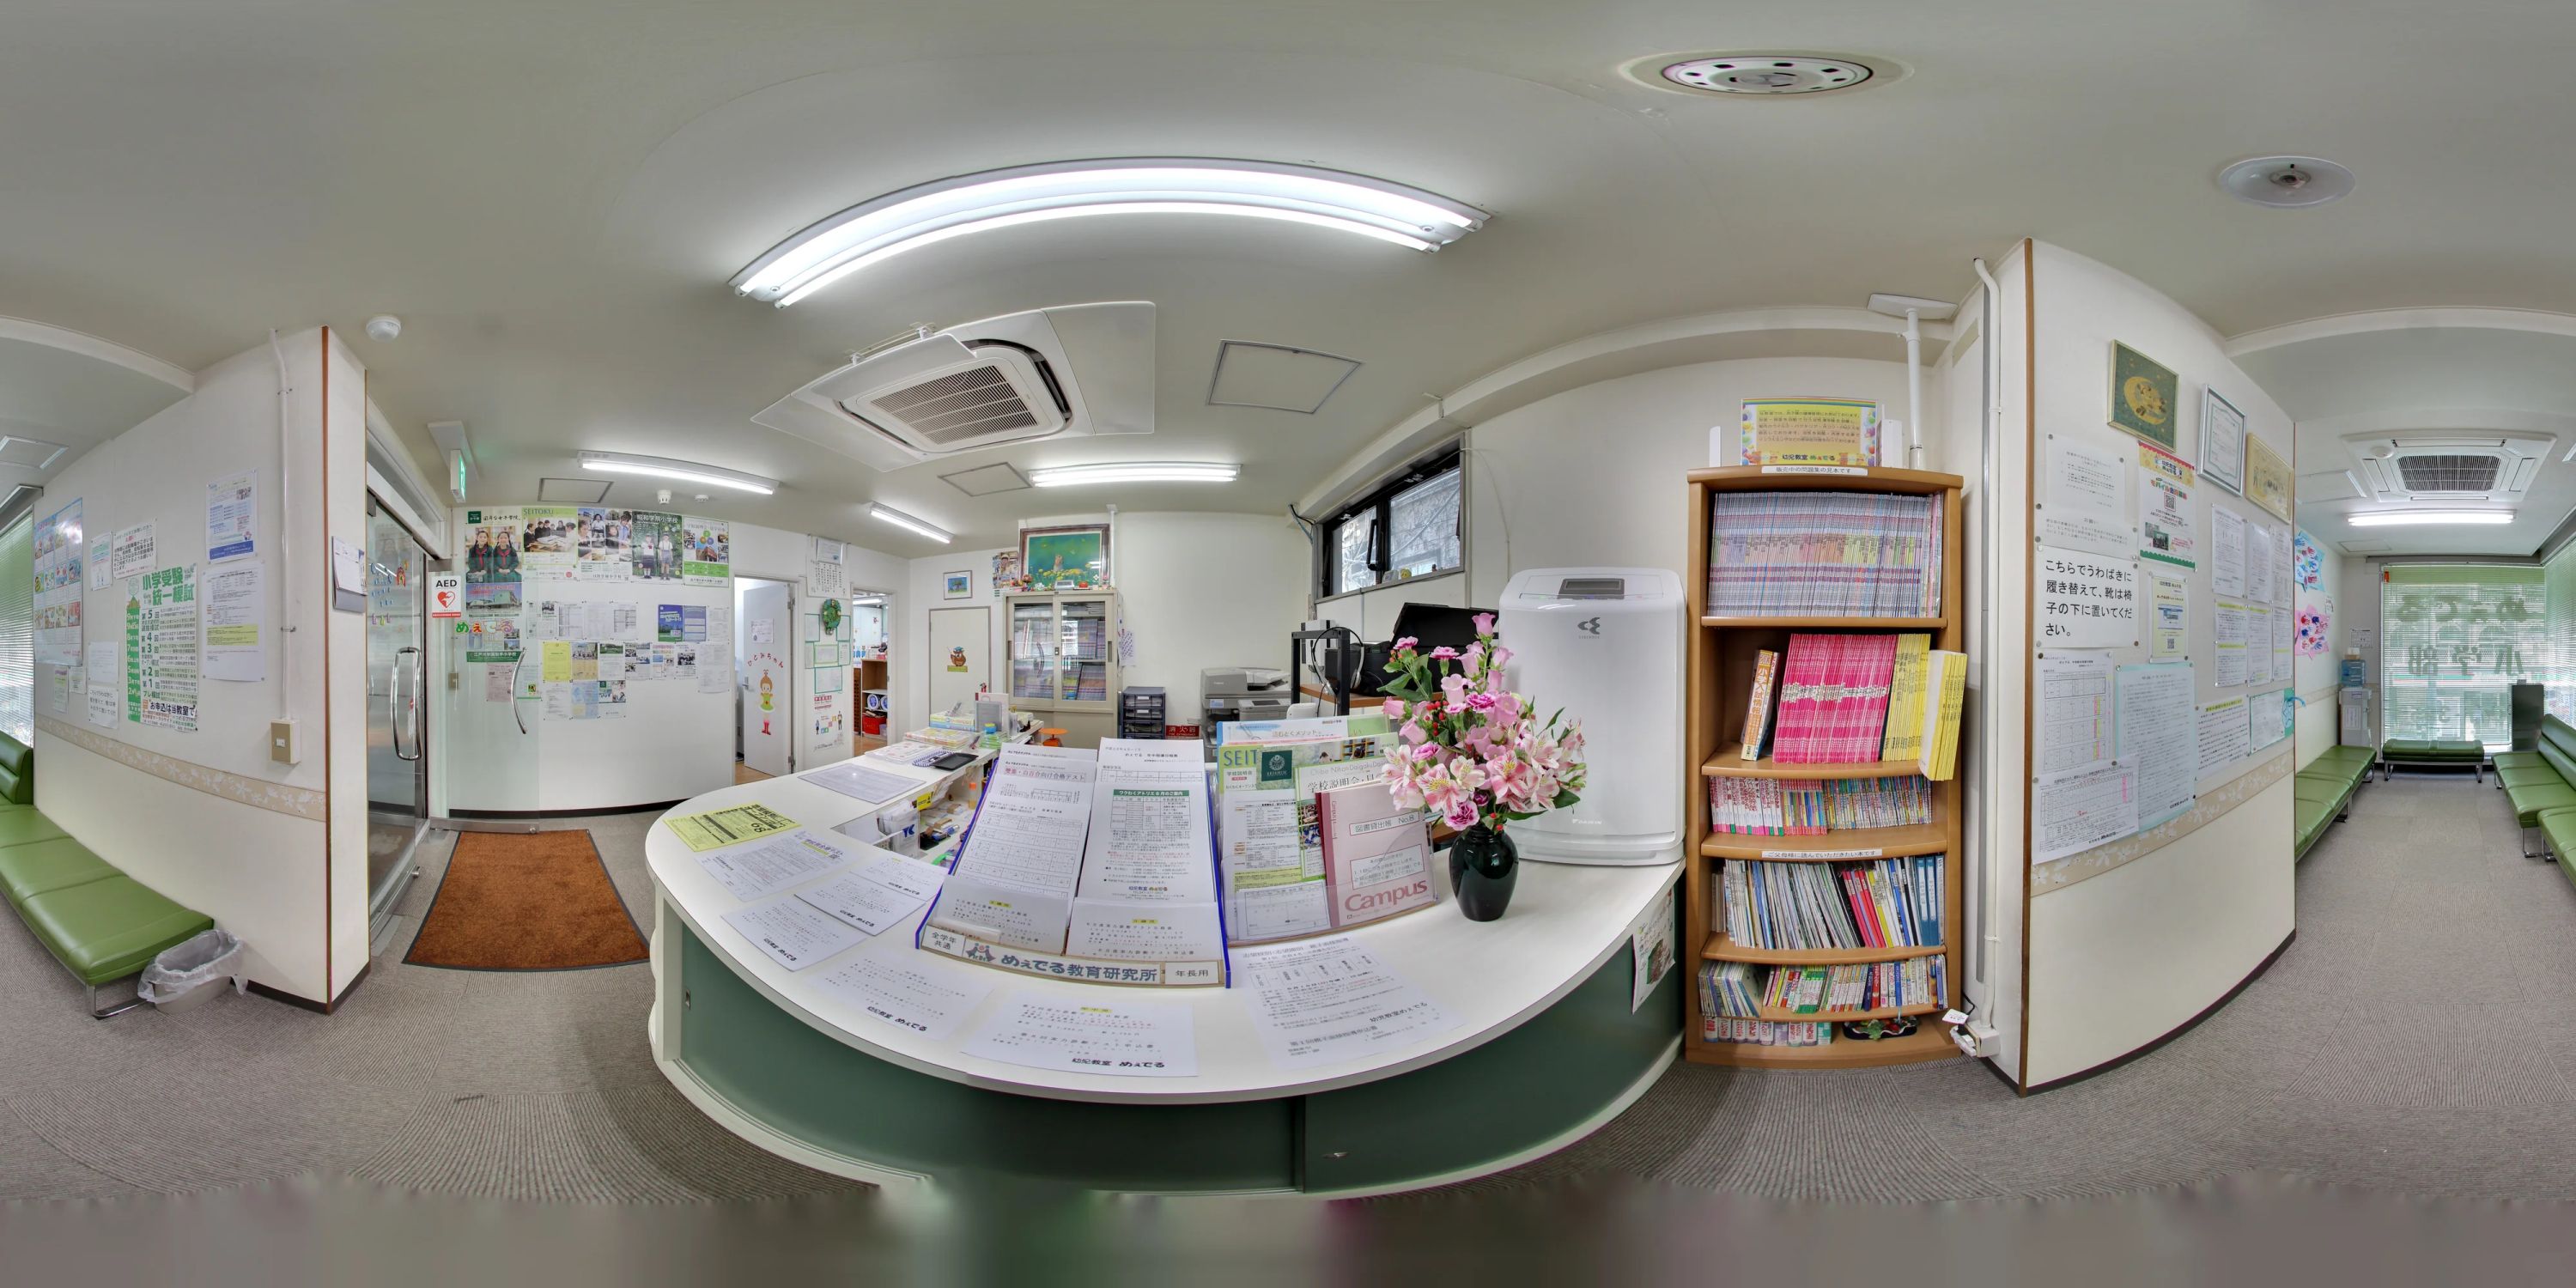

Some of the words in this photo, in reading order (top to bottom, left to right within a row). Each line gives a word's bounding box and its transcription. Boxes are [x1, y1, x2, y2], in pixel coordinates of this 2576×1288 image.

[143, 567, 183, 591] 小学受験
[2045, 560, 2132, 581] こちらでうわばきに
[2046, 580, 2132, 601] 履き替えて、靴は椅
[2046, 601, 2132, 618] 子の下に置いてくだ
[2045, 623, 2071, 636] さい。
[1345, 880, 1427, 912] Campus
[932, 931, 957, 944] 全学年
[934, 940, 951, 951] 共通
[1001, 955, 1157, 981] めぇでる教育研究所
[1072, 1058, 1112, 1066] 幼児教室
